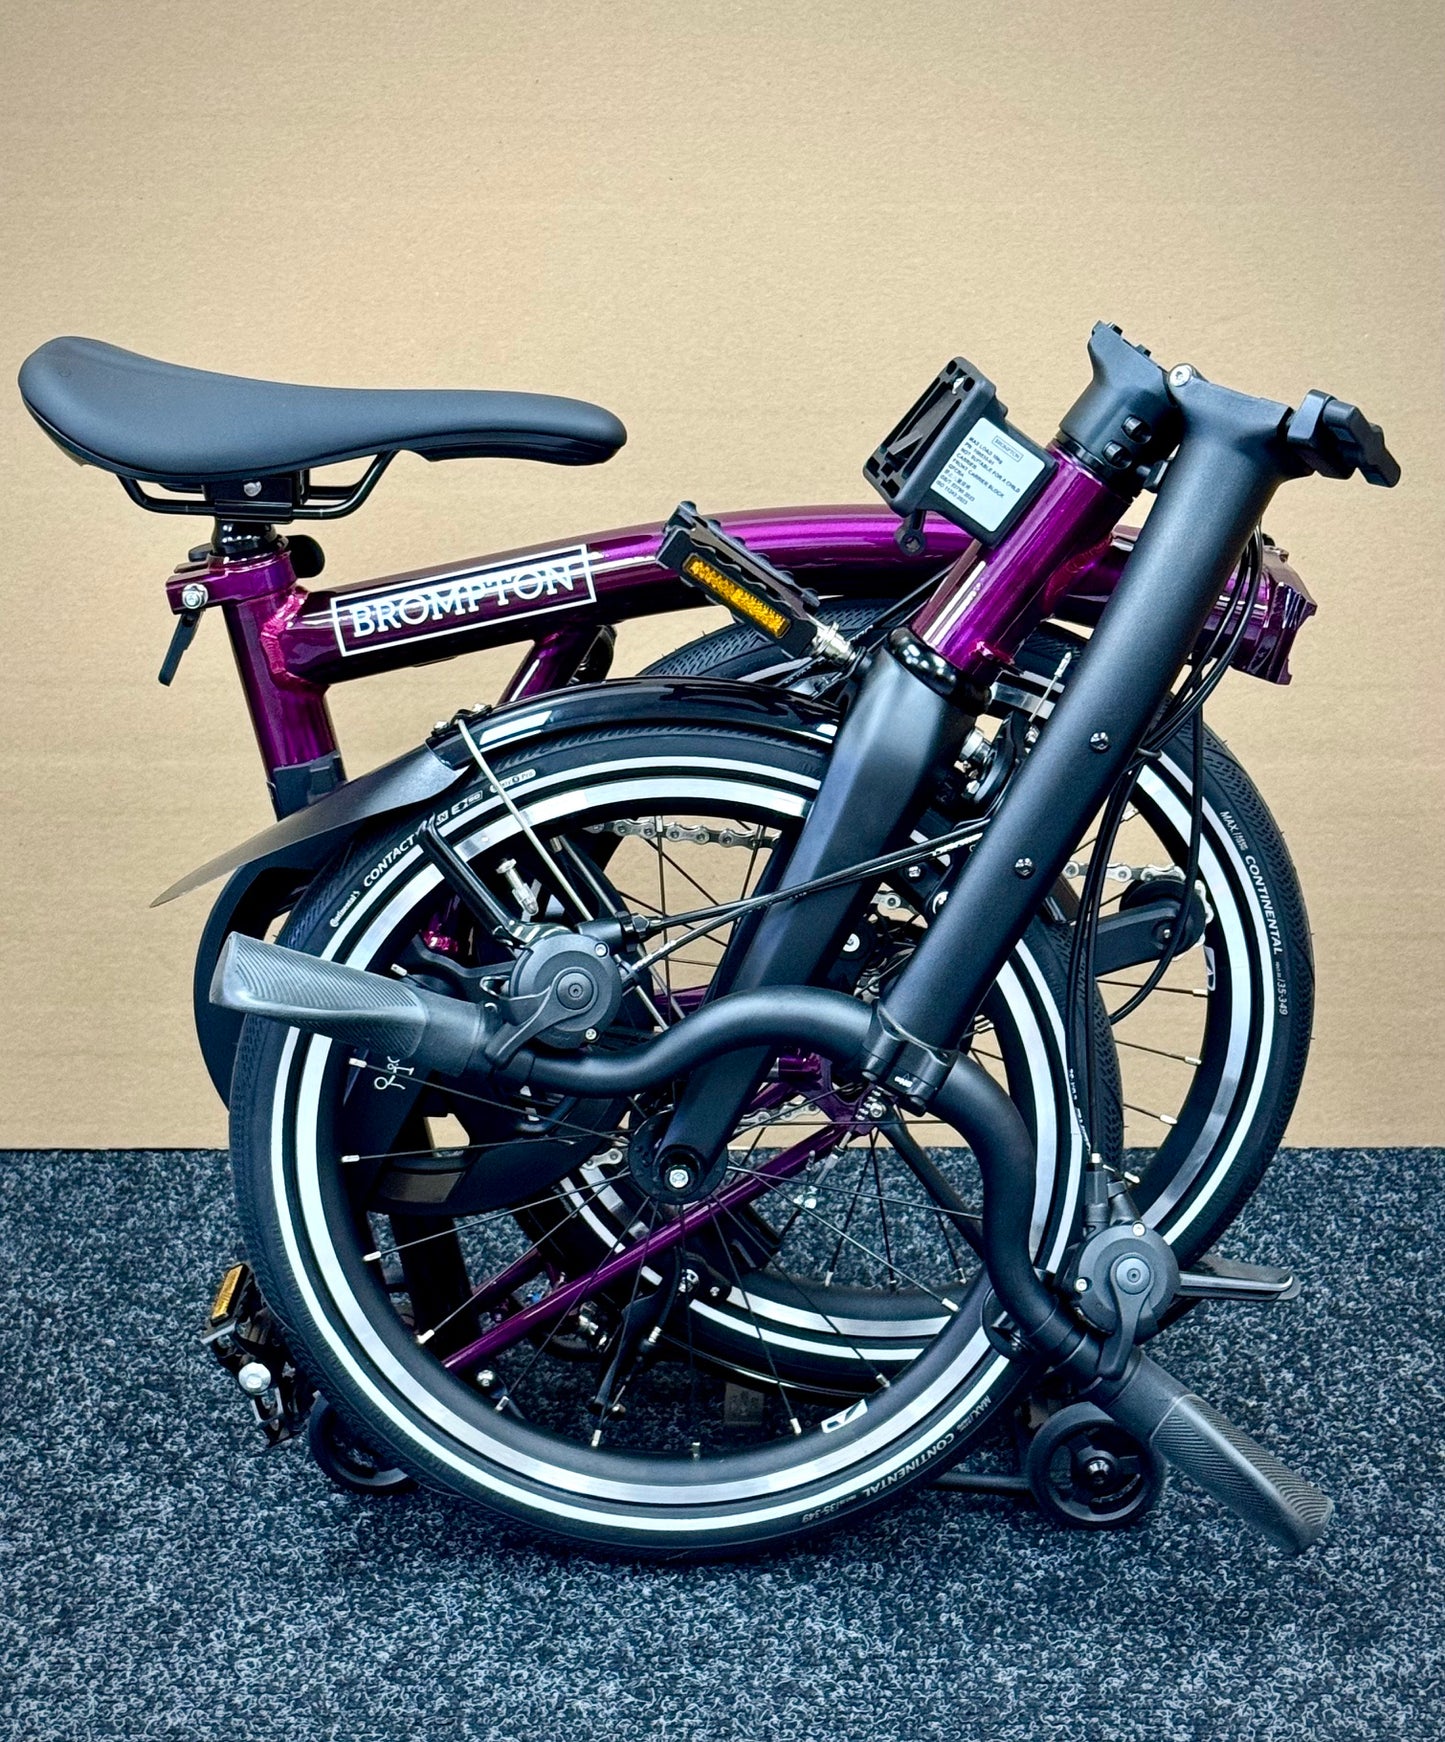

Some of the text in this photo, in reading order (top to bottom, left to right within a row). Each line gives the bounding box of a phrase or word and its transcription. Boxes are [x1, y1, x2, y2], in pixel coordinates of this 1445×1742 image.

[956, 453, 977, 469] CARRIER
[960, 448, 971, 457] NOT
[970, 455, 993, 473] SUITABLE
[992, 471, 1003, 480] FOR
[1005, 481, 1021, 493] CHILD
[979, 445, 993, 456] LOAD
[952, 458, 1005, 498] FRONT CARRIER BLOCK
[350, 565, 576, 637] BROMPTON
[364, 834, 416, 887] CONTACT
[1246, 855, 1283, 955] CONTINENTAL
[863, 1432, 955, 1497] CONTINENTAL
